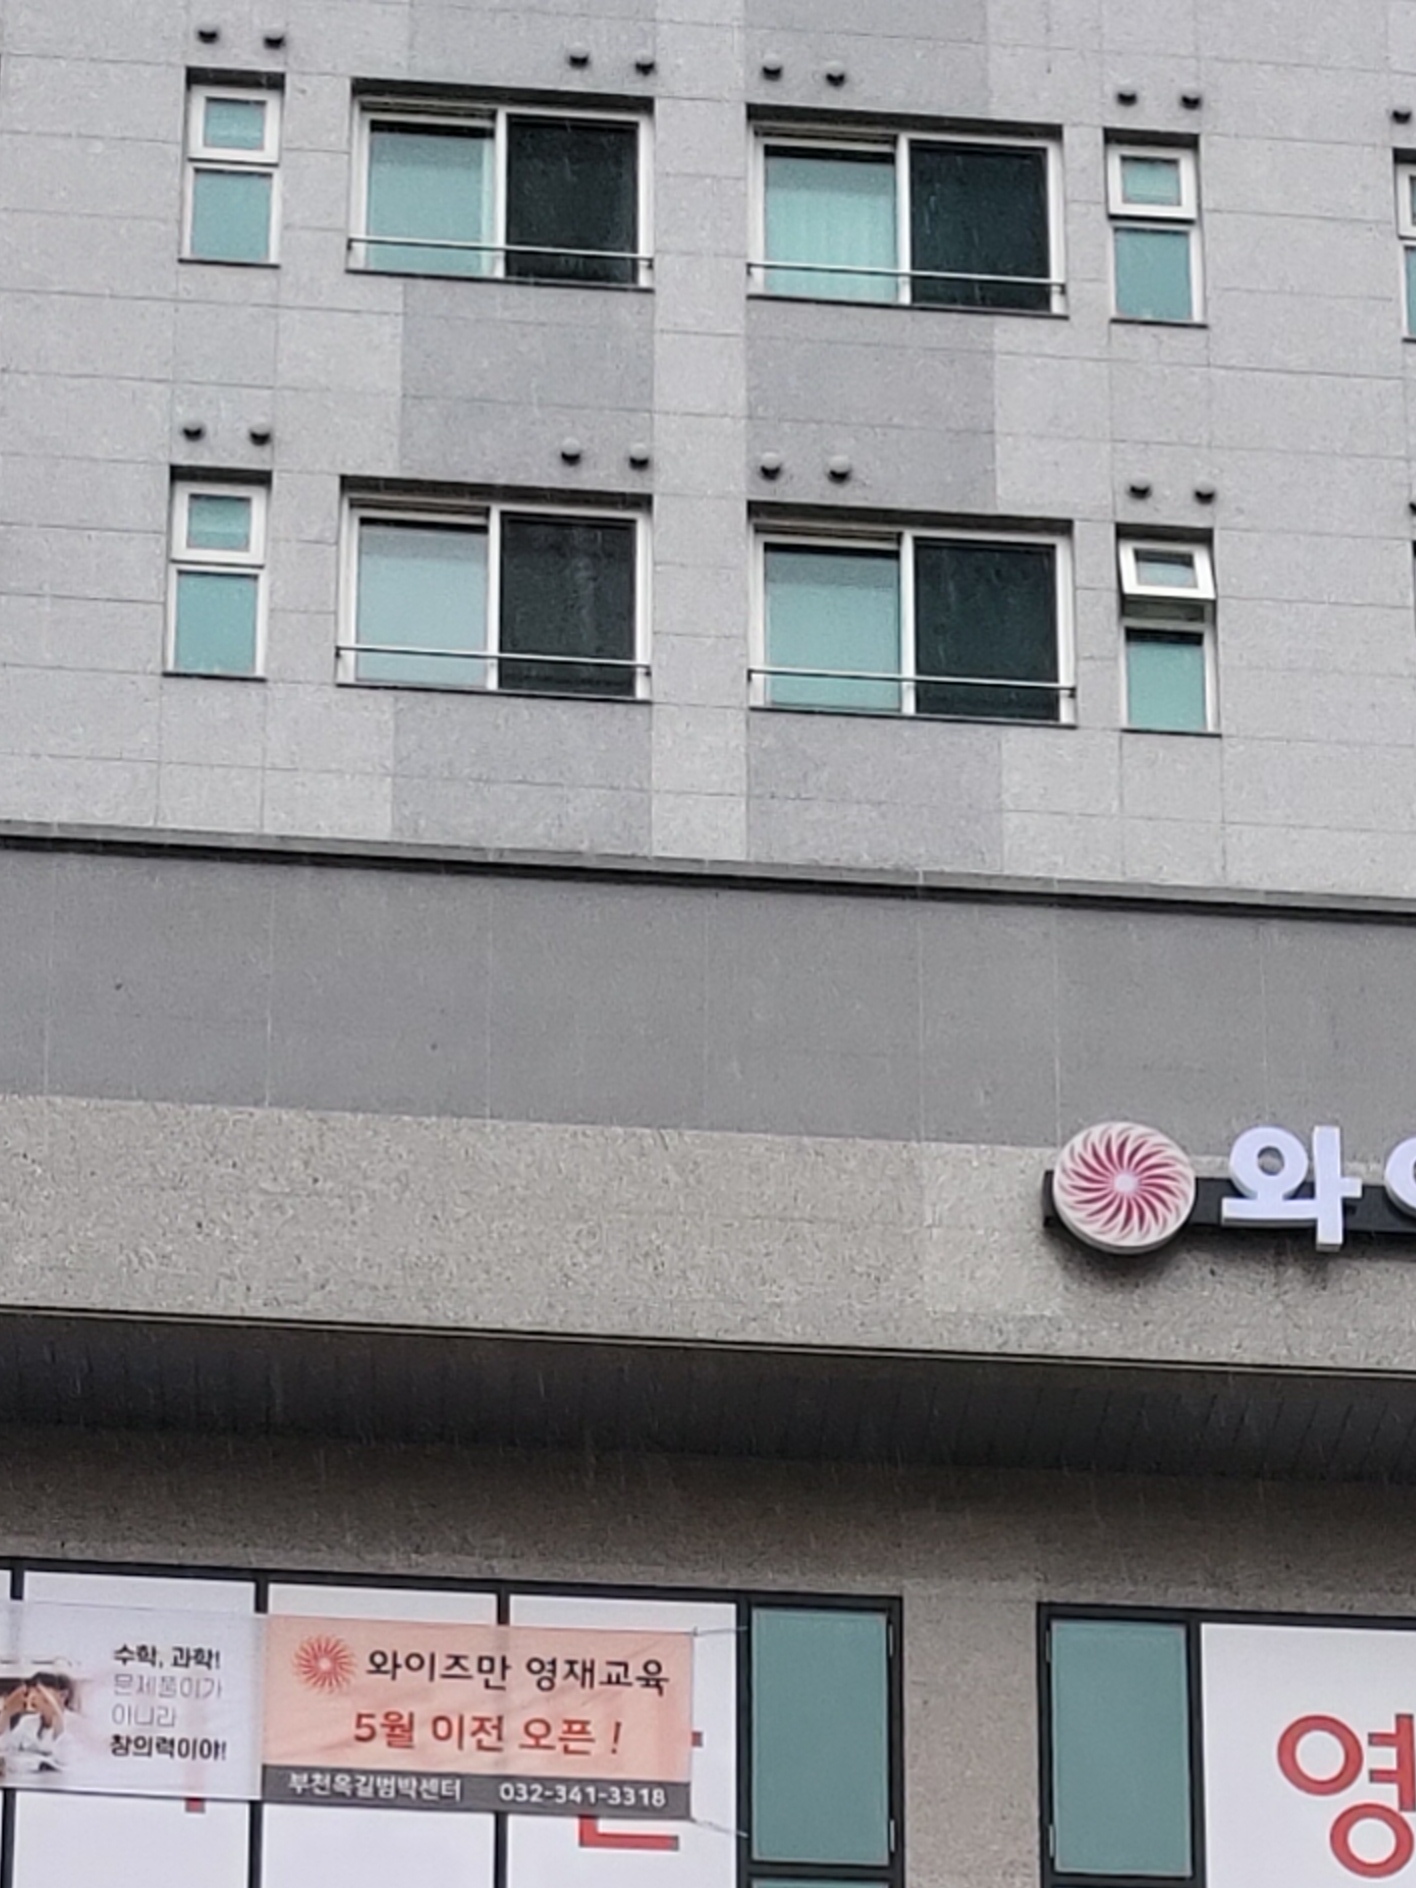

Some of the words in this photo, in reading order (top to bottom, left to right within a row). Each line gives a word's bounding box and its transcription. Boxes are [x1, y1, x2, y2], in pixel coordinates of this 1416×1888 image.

[113, 1644, 164, 1668] 수학,
[171, 1646, 222, 1670] 과학!
[366, 1649, 512, 1691] 와이즈만
[526, 1655, 671, 1698] 영재교육
[111, 1703, 177, 1728] 아니라
[110, 1734, 227, 1762] 창의력이야!
[354, 1711, 416, 1750] 5월
[432, 1713, 505, 1752] 이전
[519, 1718, 596, 1756] 오픈
[288, 1772, 463, 1802] 부천옥길범박센터
[499, 1782, 667, 1808] 032-341-3318
